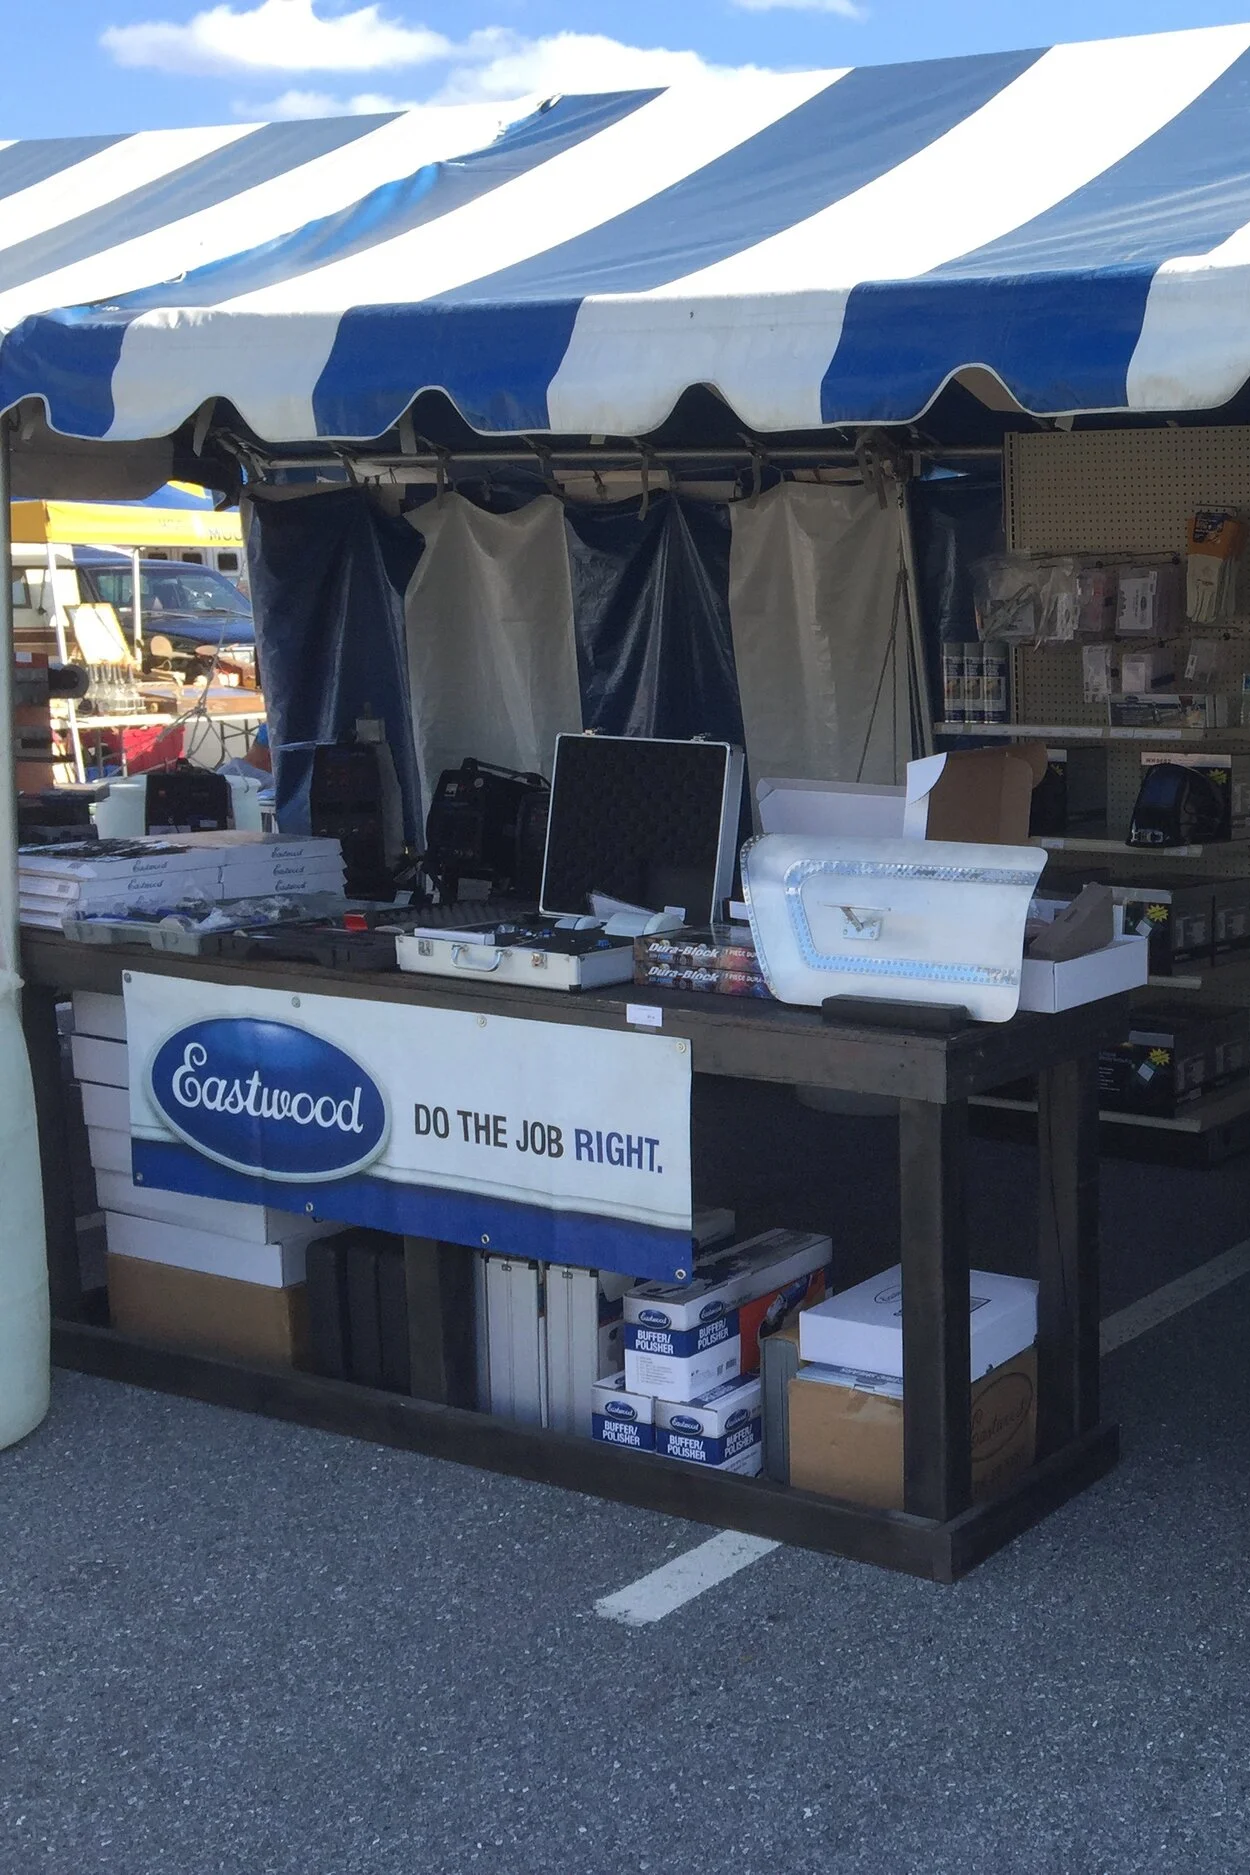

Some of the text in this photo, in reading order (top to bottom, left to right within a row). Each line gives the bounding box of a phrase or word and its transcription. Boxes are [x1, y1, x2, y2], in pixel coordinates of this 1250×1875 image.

[648, 942, 720, 958] Dura-Block
[648, 966, 720, 982] Dura-Block
[172, 1042, 363, 1134] Eastwood
[414, 1103, 663, 1174] DO THE JOB RIGHT.
[637, 1329, 671, 1343] BUFFER/
[698, 1327, 728, 1350] POLISHER
[635, 1339, 674, 1354] POLISHER
[604, 1420, 638, 1435] BUFFER/
[602, 1430, 640, 1446] POLISHER
[669, 1435, 704, 1450] BUFFER/
[724, 1433, 754, 1457] POLISHER
[667, 1443, 706, 1461] POLISHER
